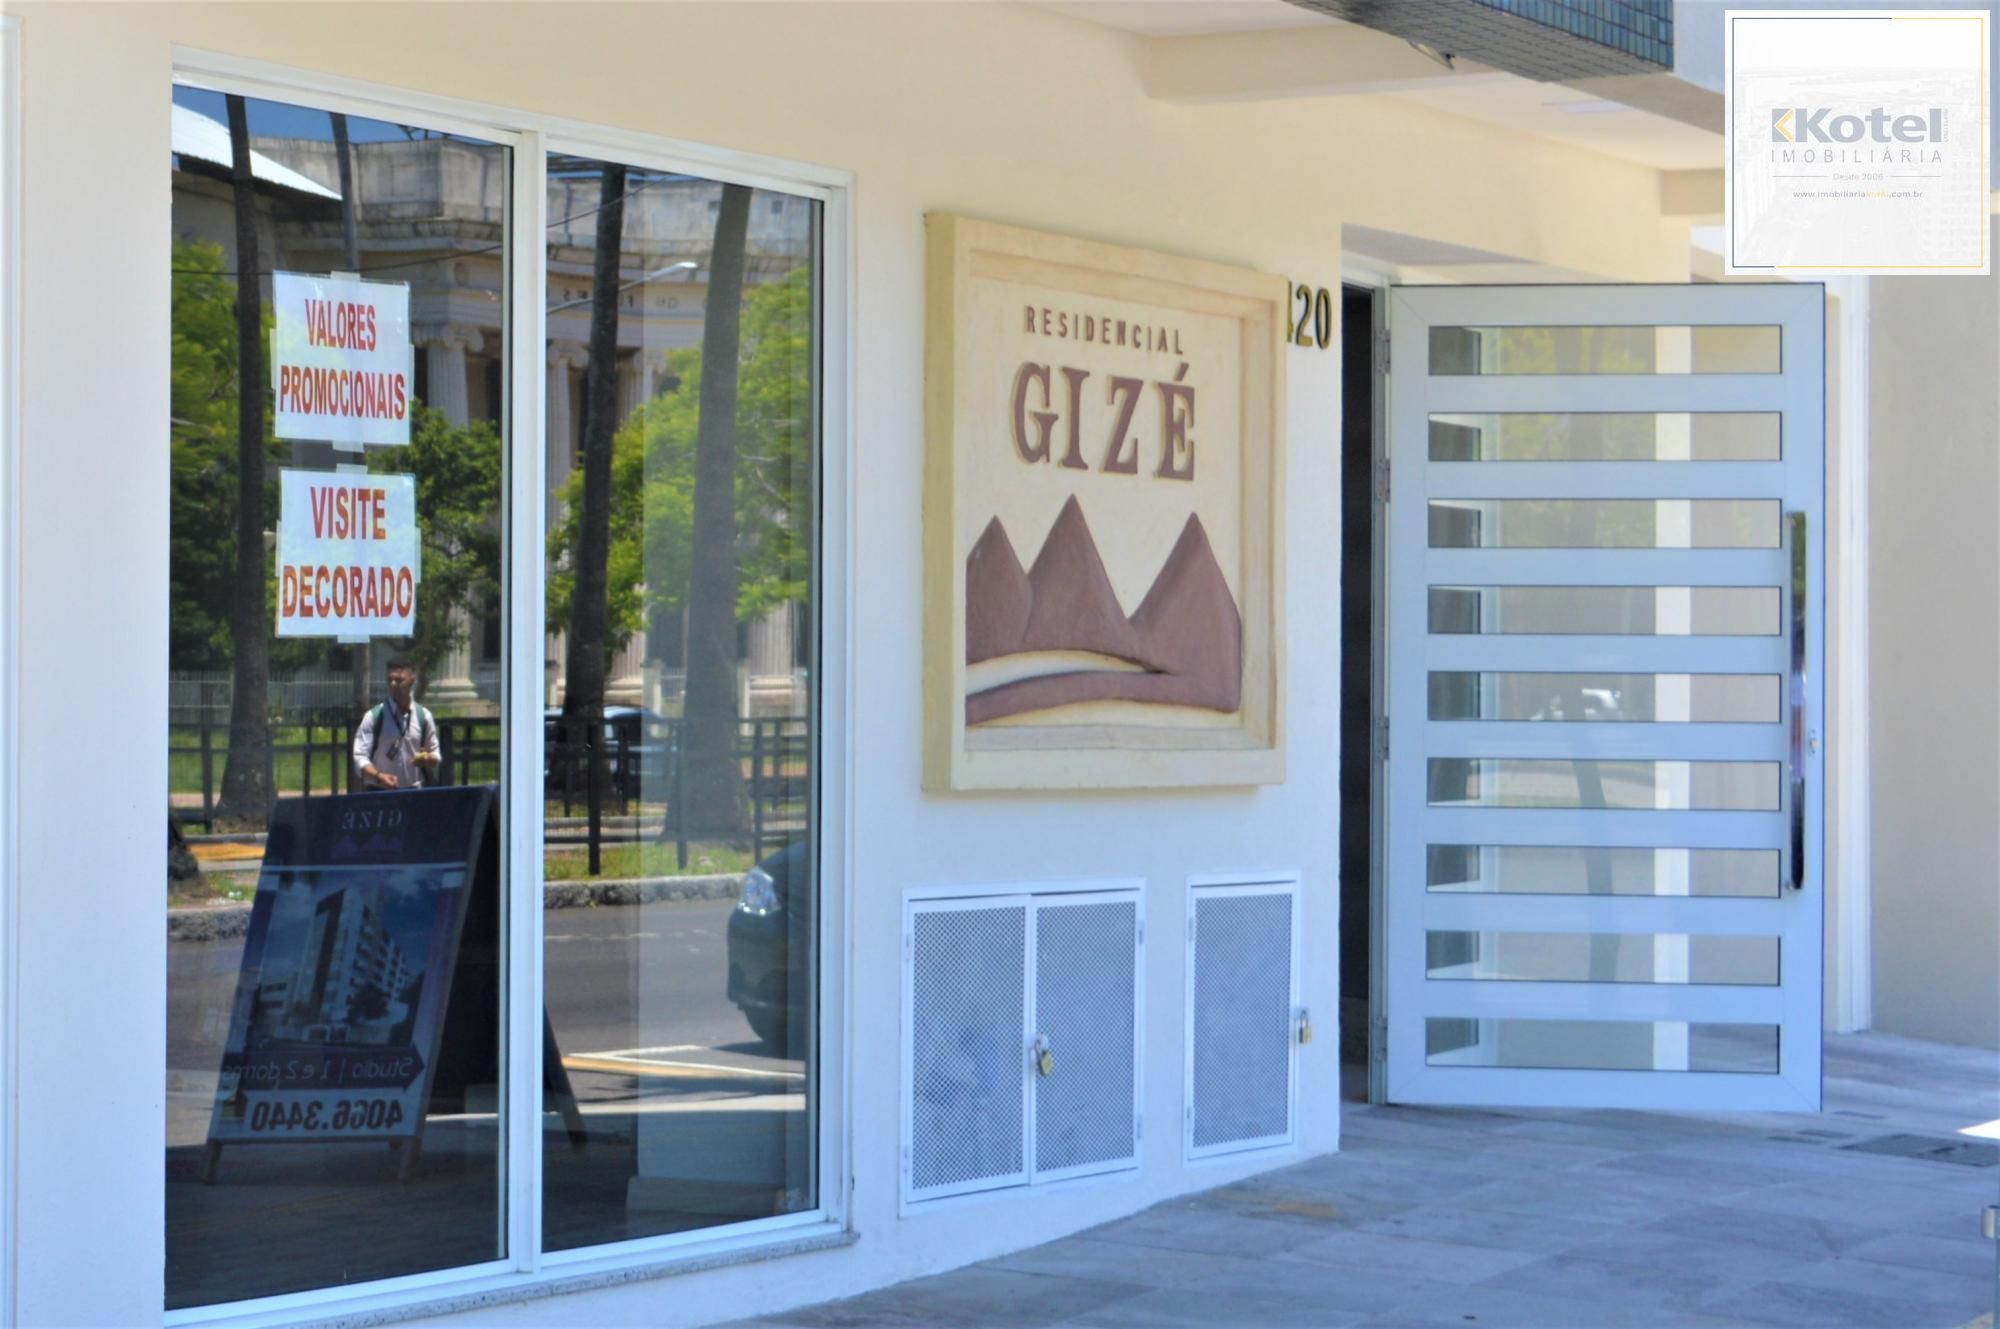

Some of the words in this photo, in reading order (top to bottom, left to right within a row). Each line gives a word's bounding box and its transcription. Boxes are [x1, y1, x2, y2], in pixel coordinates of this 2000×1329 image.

[305, 299, 377, 352] VALORES
[1024, 304, 1184, 356] RESIDENCIAL
[280, 365, 406, 420] PROMOCIONAIS
[1011, 361, 1196, 481] GIZÉ
[310, 486, 387, 540] VISITE
[282, 565, 413, 618] DECORADO
